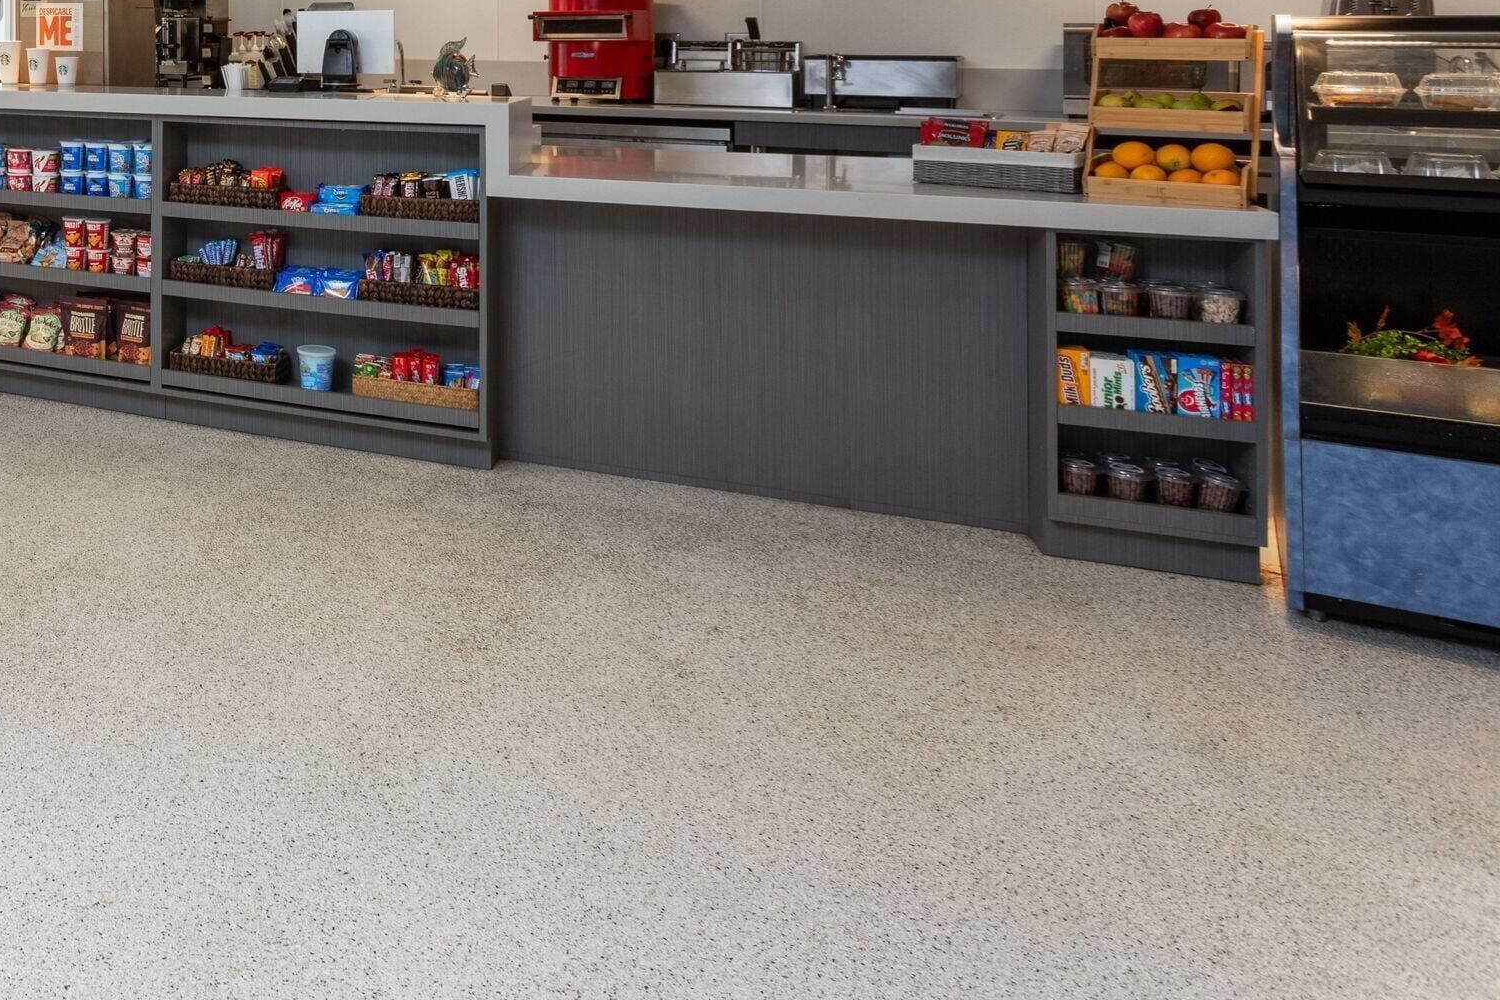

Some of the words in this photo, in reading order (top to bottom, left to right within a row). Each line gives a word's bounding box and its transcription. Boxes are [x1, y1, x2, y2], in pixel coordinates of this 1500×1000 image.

[39, 7, 73, 16] DESPICABLE
[39, 15, 73, 46] ME
[1101, 376, 1113, 408] unior
[1113, 371, 1122, 395] Mints
